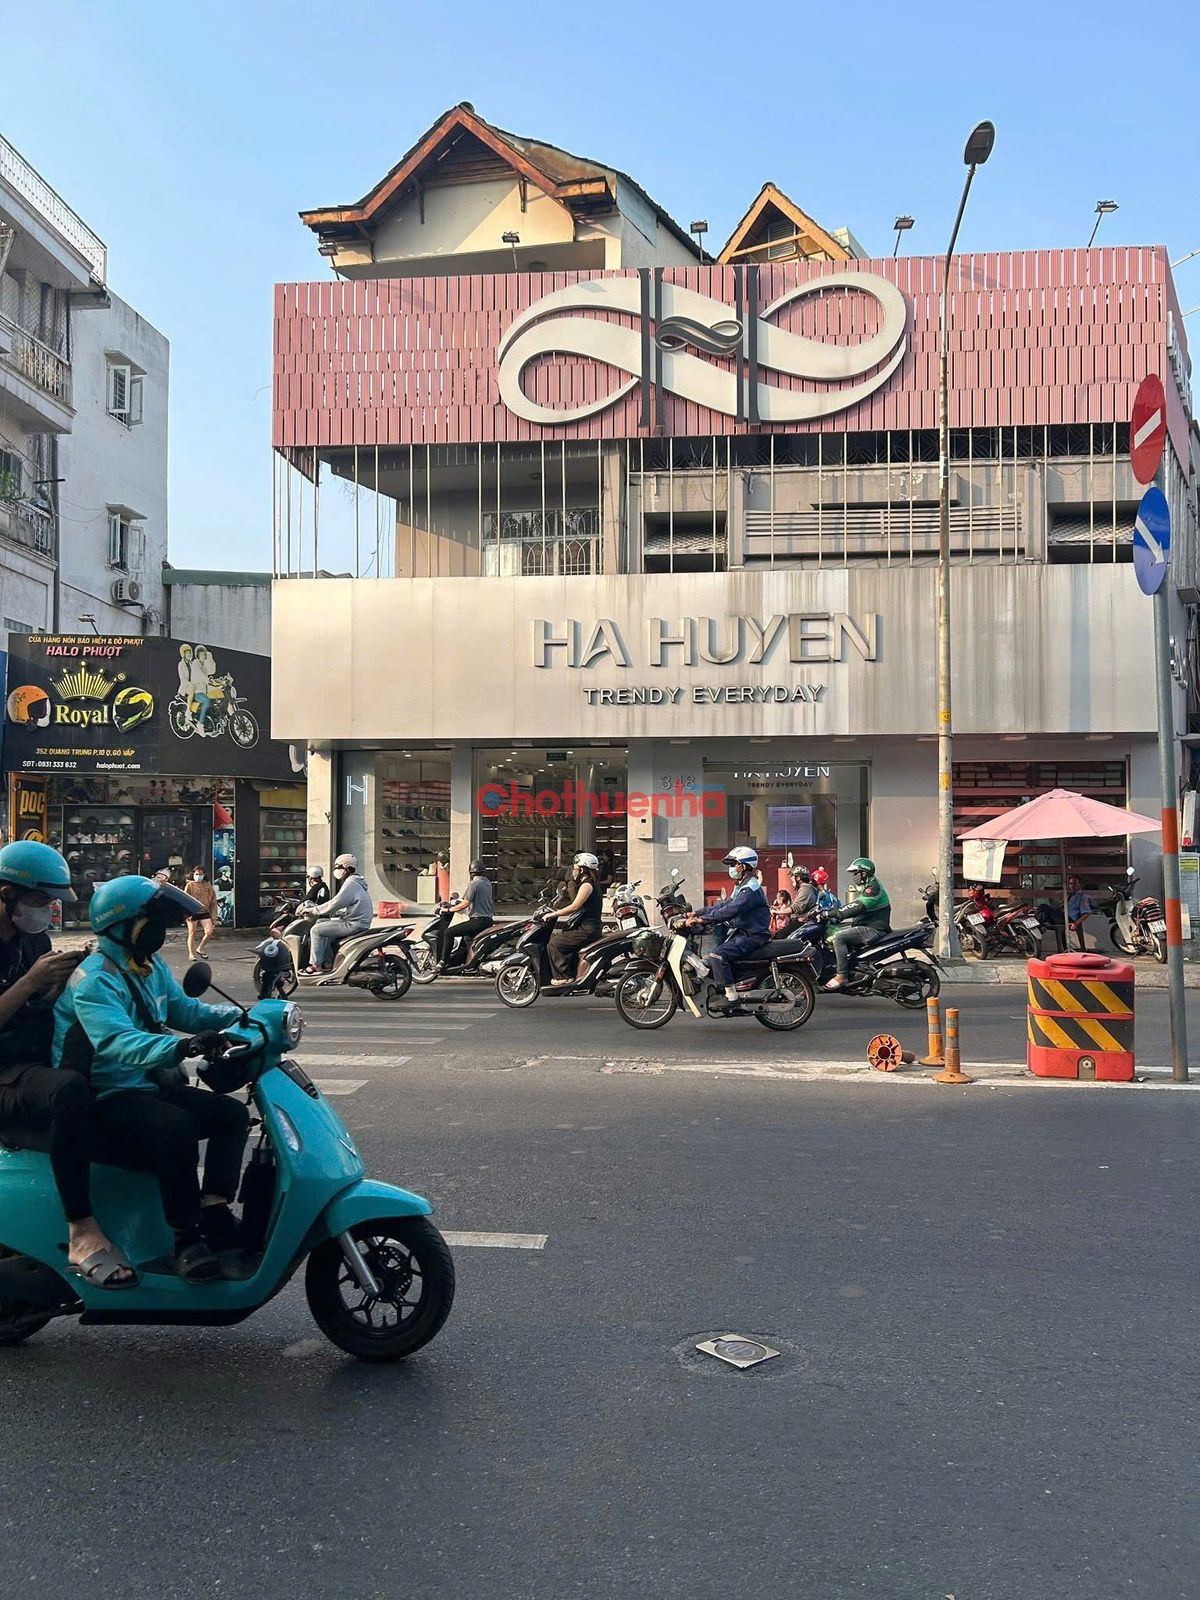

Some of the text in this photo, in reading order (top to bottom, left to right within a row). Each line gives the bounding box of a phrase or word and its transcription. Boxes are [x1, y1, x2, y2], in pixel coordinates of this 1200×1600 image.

[533, 612, 880, 667] HA HUYEN
[46, 646, 79, 657] HALO
[584, 684, 824, 704] TRENDY EVERYDAY
[55, 704, 108, 728] Royal
[48, 748, 70, 756] QUANG
[660, 775, 696, 790] 348
